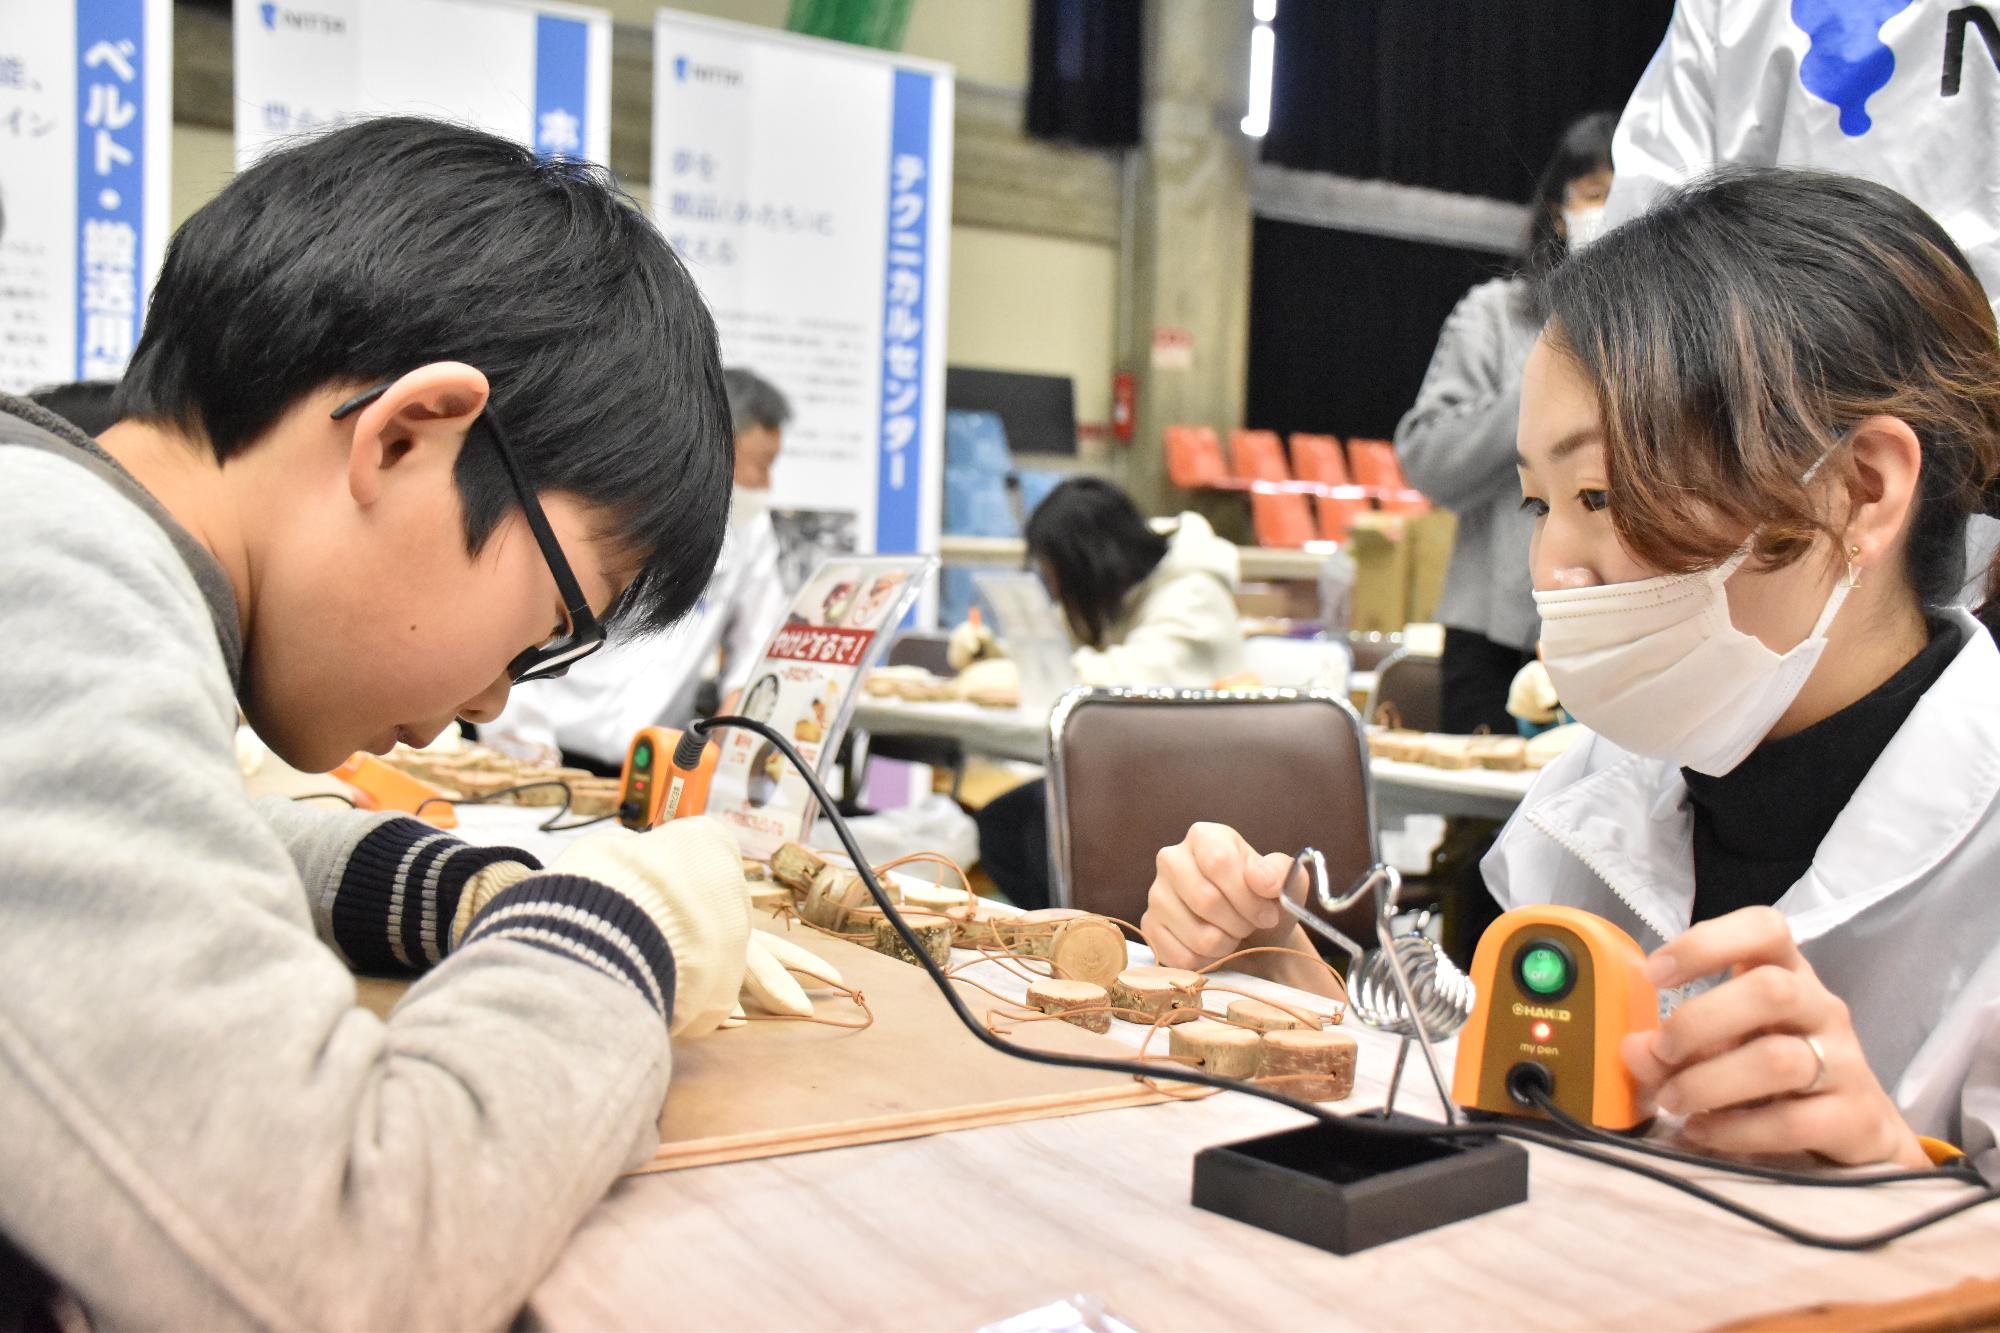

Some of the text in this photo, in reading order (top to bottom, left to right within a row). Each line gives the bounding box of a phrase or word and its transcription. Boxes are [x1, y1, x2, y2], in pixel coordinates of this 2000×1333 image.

[884, 153, 926, 490] テクニカルセンター
[1520, 1043, 1536, 1054] my
